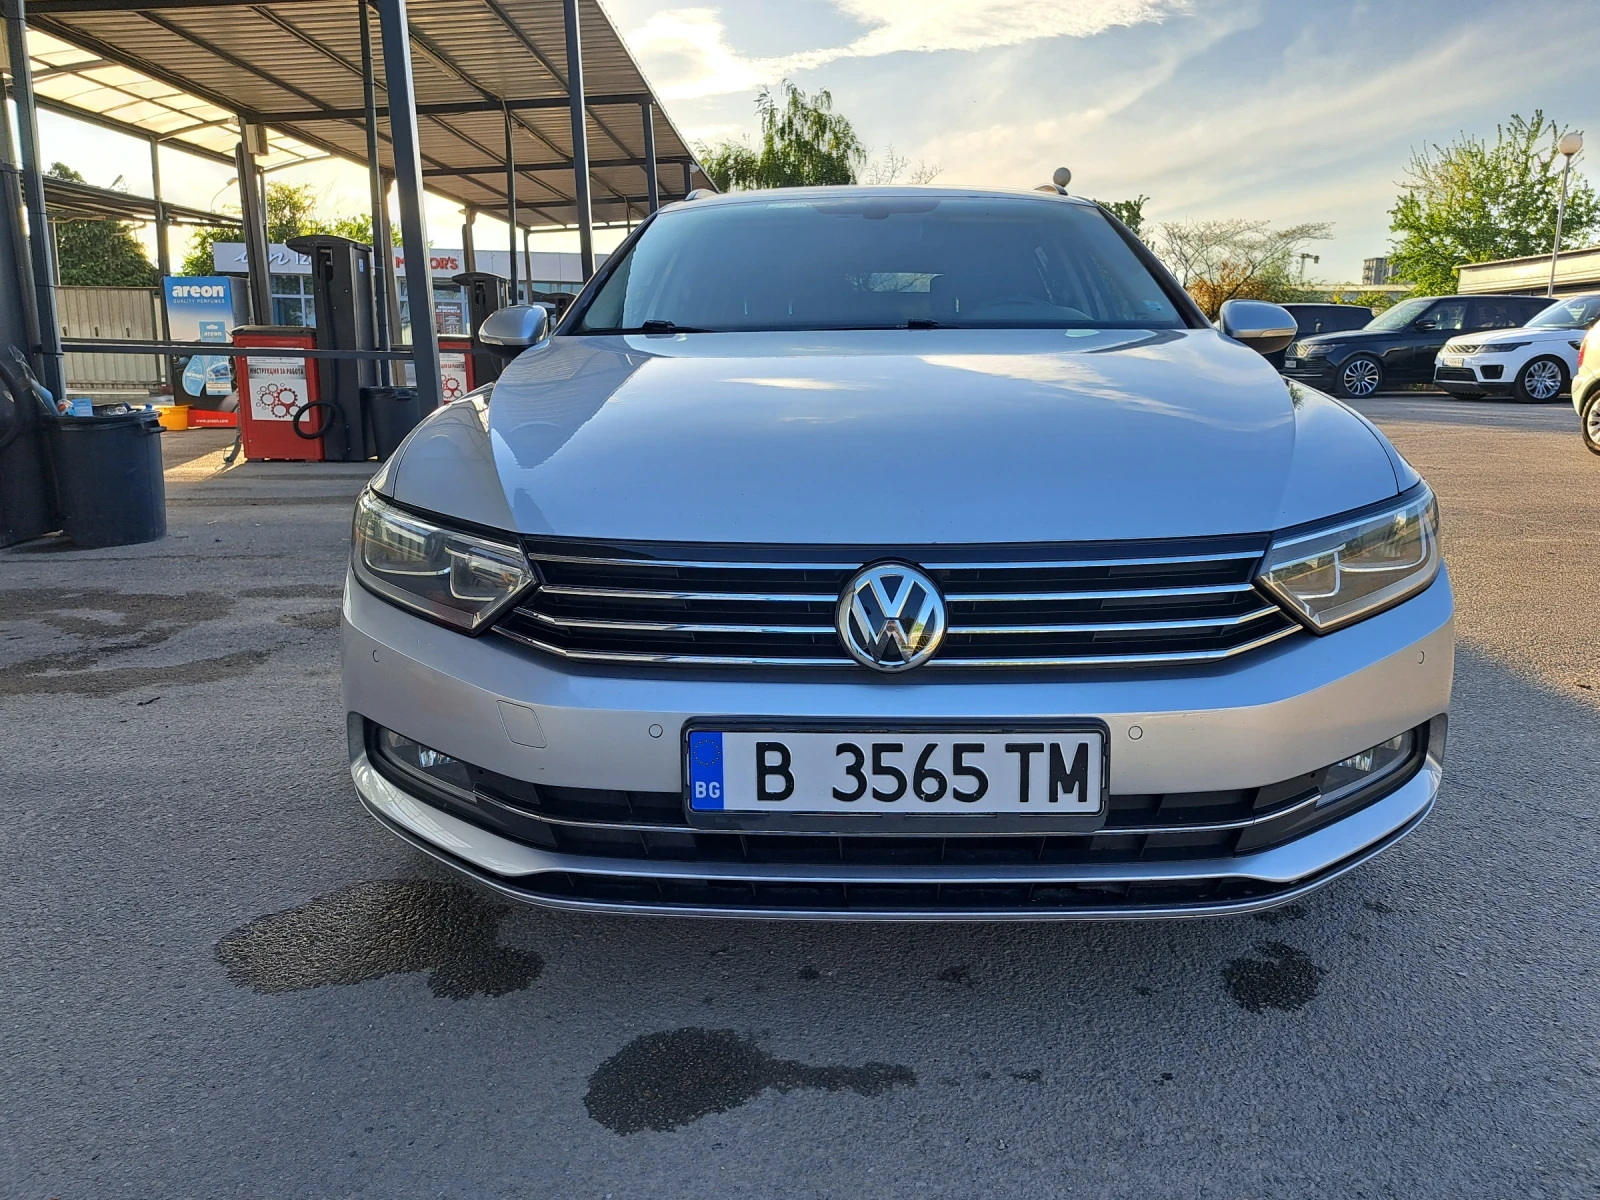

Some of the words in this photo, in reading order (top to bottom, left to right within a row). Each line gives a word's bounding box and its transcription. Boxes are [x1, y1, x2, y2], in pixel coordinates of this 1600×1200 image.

[395, 256, 458, 270] MOR'S
[172, 285, 224, 297] areon
[756, 741, 795, 801] B
[832, 742, 989, 803] 3565
[1005, 742, 1088, 803] TM
[695, 781, 720, 799] BG
